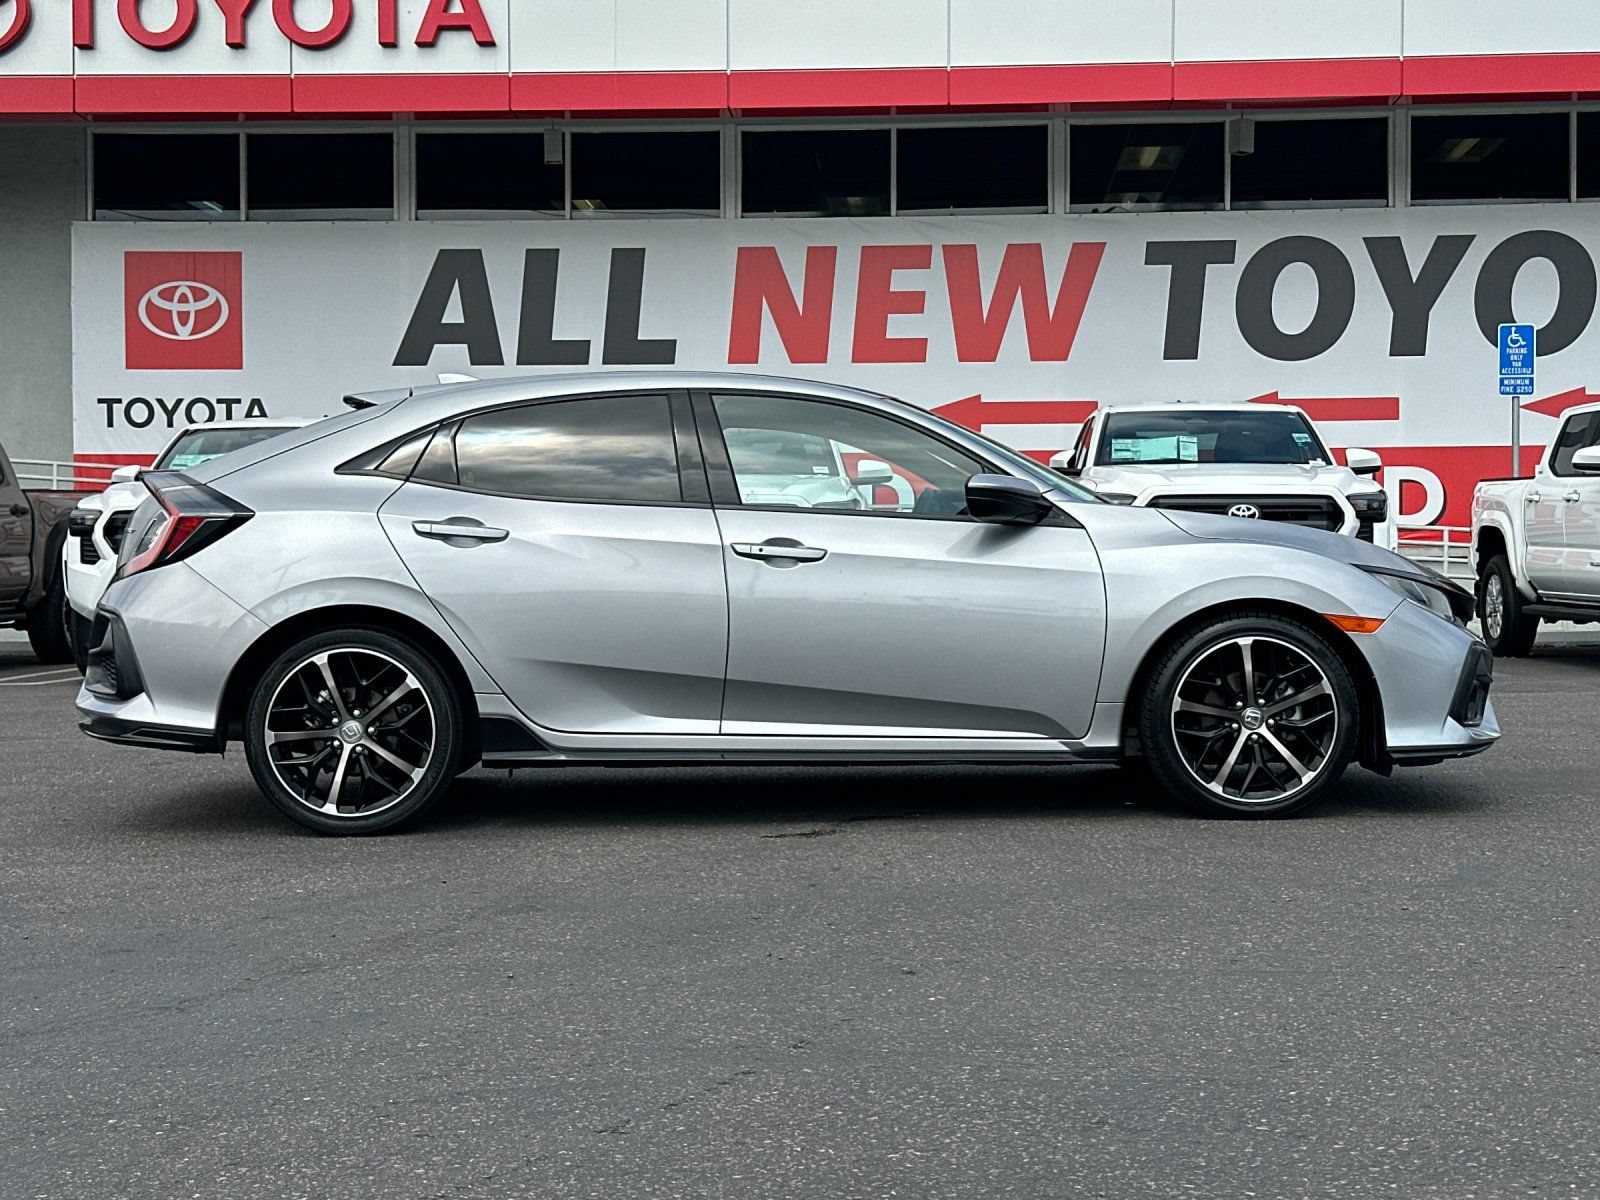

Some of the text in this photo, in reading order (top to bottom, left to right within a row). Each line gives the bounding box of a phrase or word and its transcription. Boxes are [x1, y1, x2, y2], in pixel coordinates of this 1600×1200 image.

[391, 229, 1598, 367] ALL NEW TOYO
[1517, 386, 1533, 394] $250
[97, 397, 269, 428] TOYOTA
